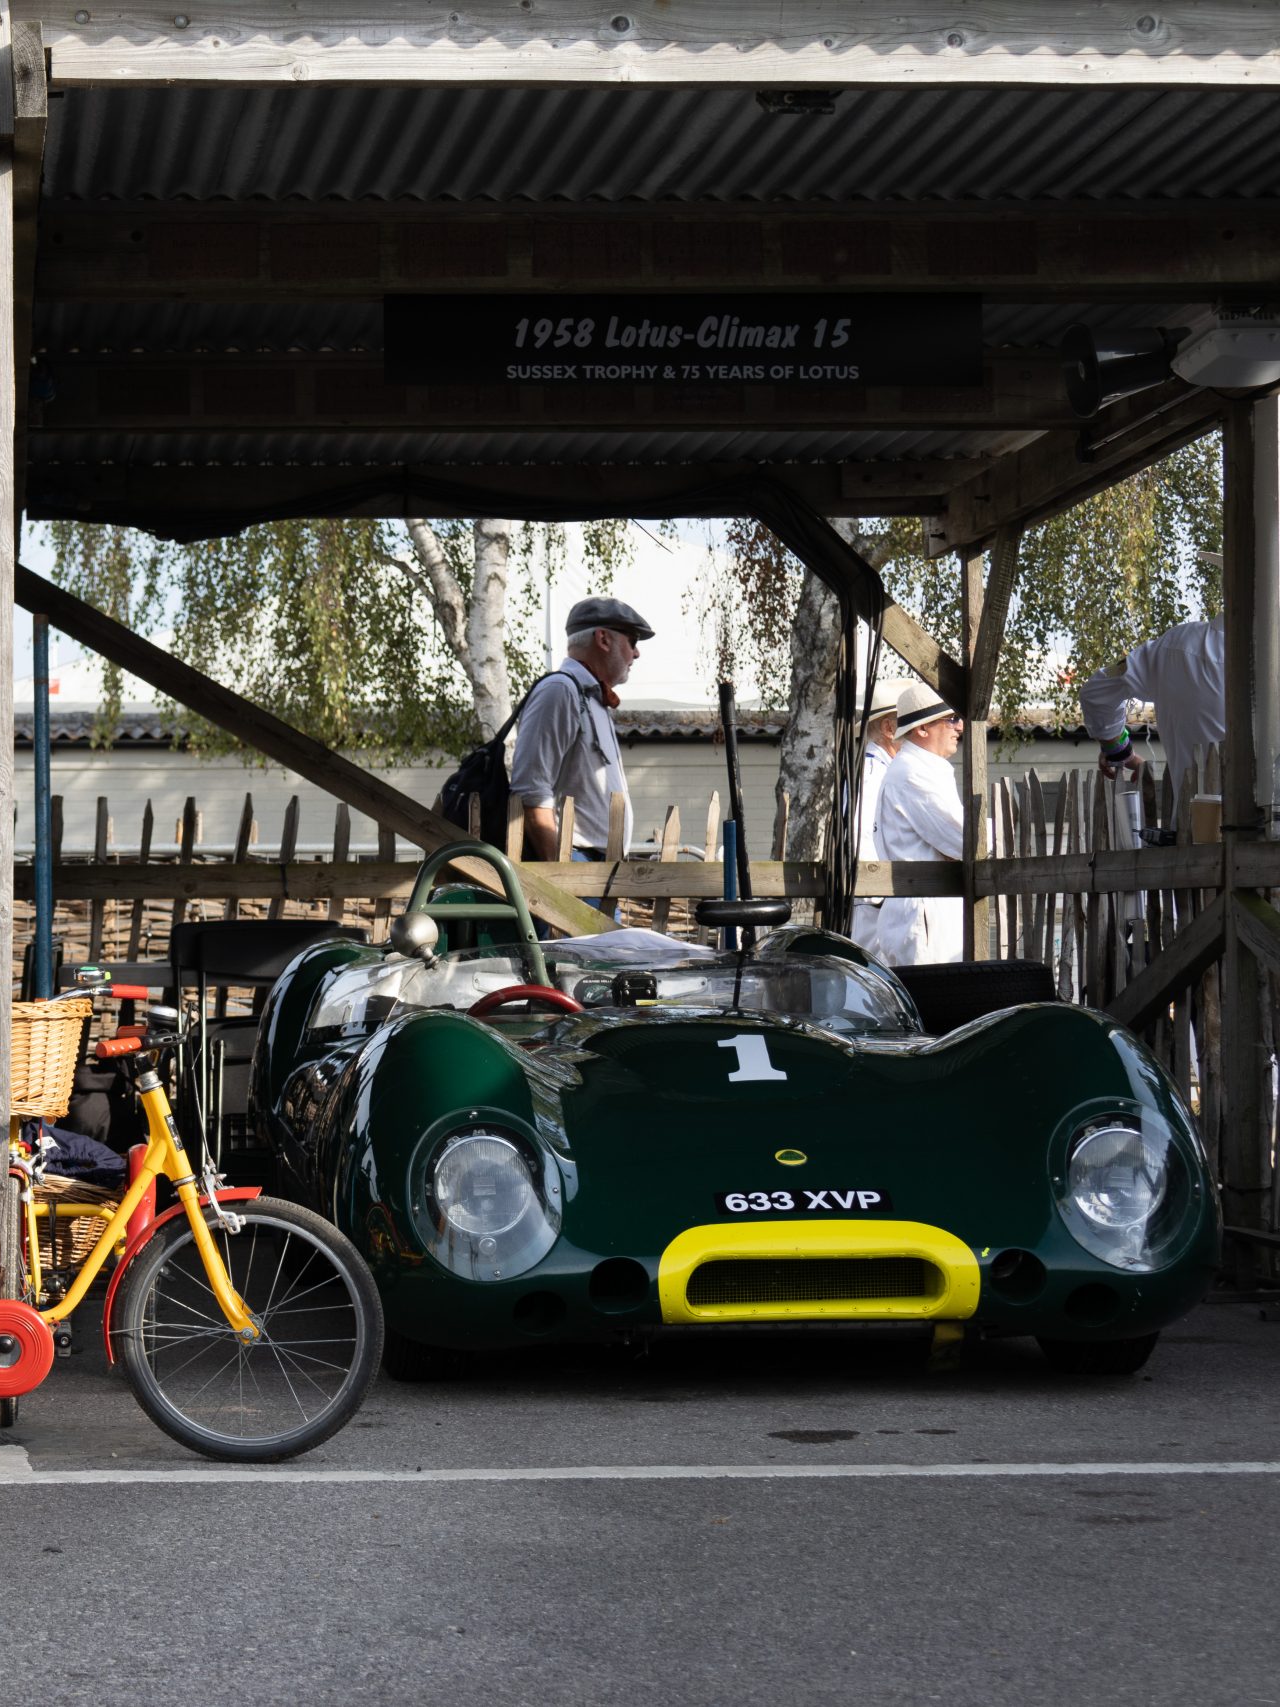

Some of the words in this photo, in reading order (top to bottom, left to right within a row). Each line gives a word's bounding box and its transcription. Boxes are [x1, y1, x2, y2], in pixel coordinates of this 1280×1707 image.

[514, 318, 595, 348] 1958
[605, 315, 799, 348] Lotus-Climax
[814, 318, 852, 348] 15
[507, 365, 577, 379] SUSSEX
[583, 365, 658, 379] TROPHY
[662, 365, 676, 379] &
[681, 365, 700, 379] 75
[705, 365, 765, 379] YEARS
[769, 365, 794, 379] OF
[799, 365, 859, 379] LOTUS
[717, 1034, 788, 1082] 1
[725, 1191, 795, 1212] 633
[803, 1190, 881, 1209] XVP
